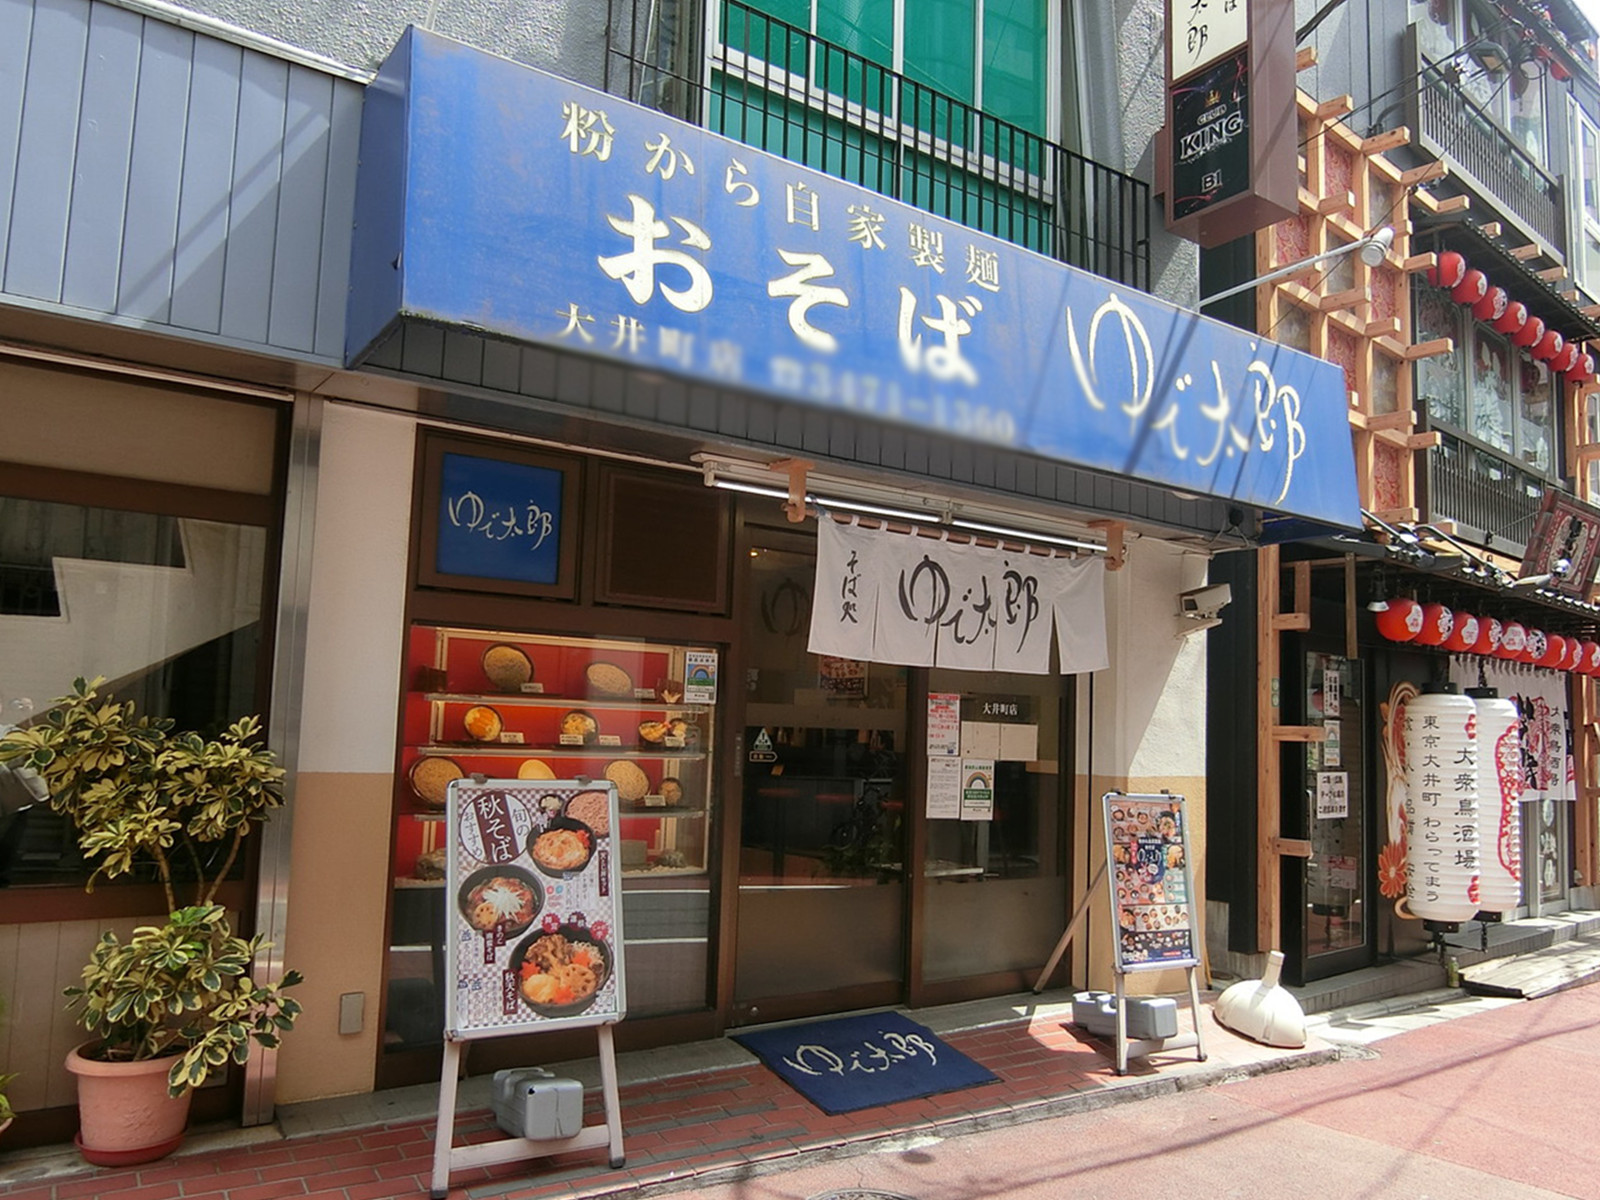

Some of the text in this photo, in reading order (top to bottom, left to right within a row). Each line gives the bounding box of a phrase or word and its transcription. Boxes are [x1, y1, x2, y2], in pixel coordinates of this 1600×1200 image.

[1180, 110, 1244, 160] KING
[560, 101, 1001, 293] 粉から自家製麺
[597, 194, 983, 386] おそば
[840, 550, 861, 624] そば処
[982, 702, 1018, 716] 大井町店
[477, 794, 513, 863] 秋そば
[513, 808, 530, 837] 旬の
[1422, 715, 1443, 902] 東京大井町 わらってまう
[1453, 747, 1477, 869] 大衆鳥酒場
